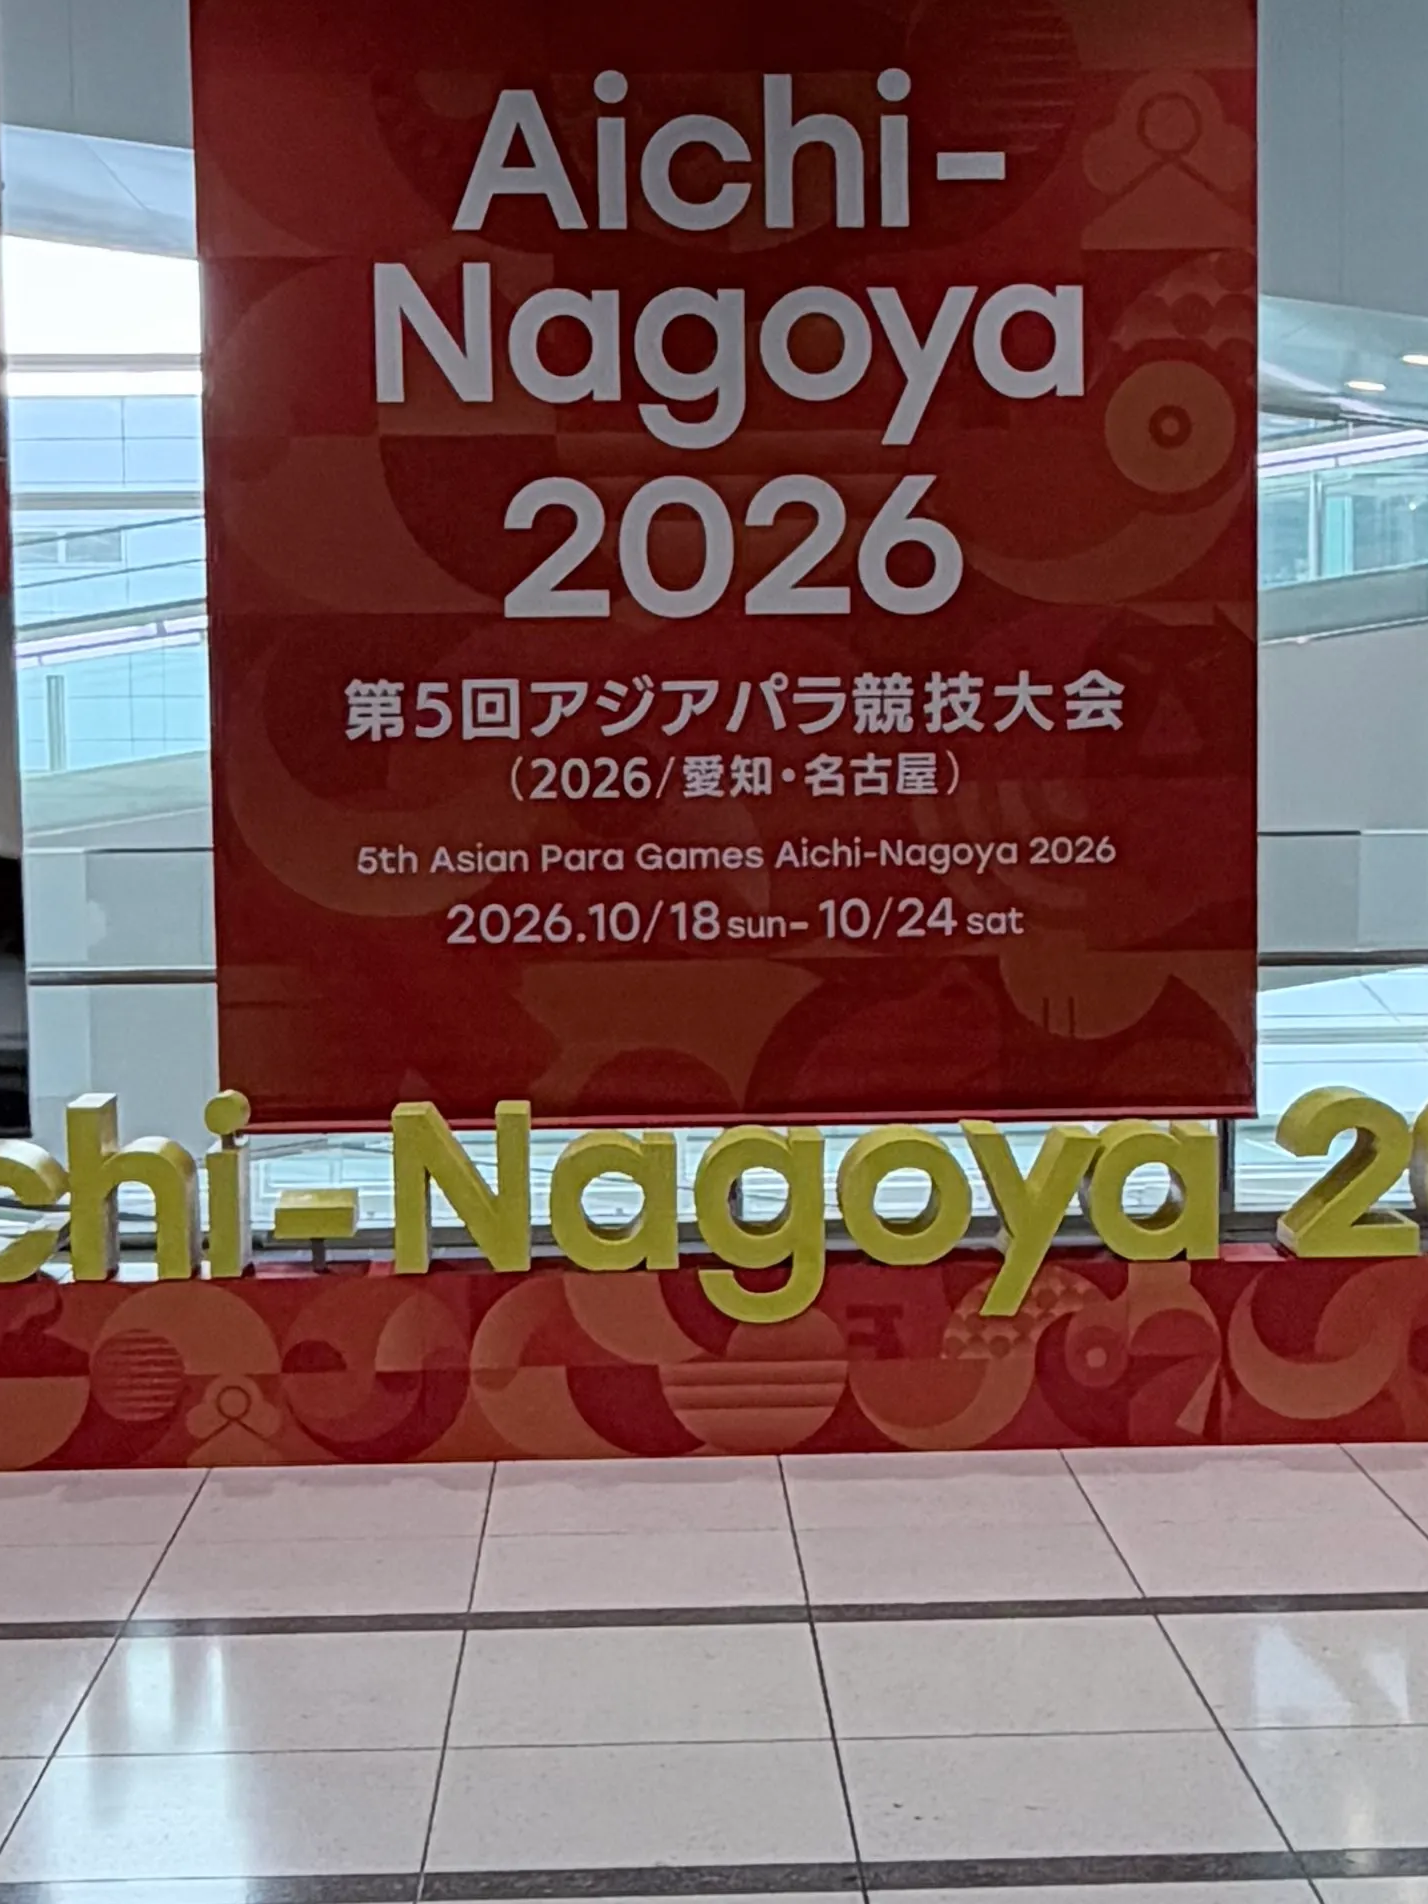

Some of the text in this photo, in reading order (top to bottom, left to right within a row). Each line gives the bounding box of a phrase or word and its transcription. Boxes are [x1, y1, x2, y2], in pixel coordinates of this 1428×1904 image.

[452, 68, 1005, 230] Aichi-
[374, 263, 1084, 449] Nagoya
[504, 475, 963, 618] 2026
[345, 670, 1124, 741] 第5回アジアパラ競技大会
[358, 836, 1116, 874] 5th Asian Para Games Aichi-Nagoya 2026
[447, 900, 720, 943] 2026.10/18
[819, 897, 957, 939] 10/24
[967, 908, 1023, 934] sat
